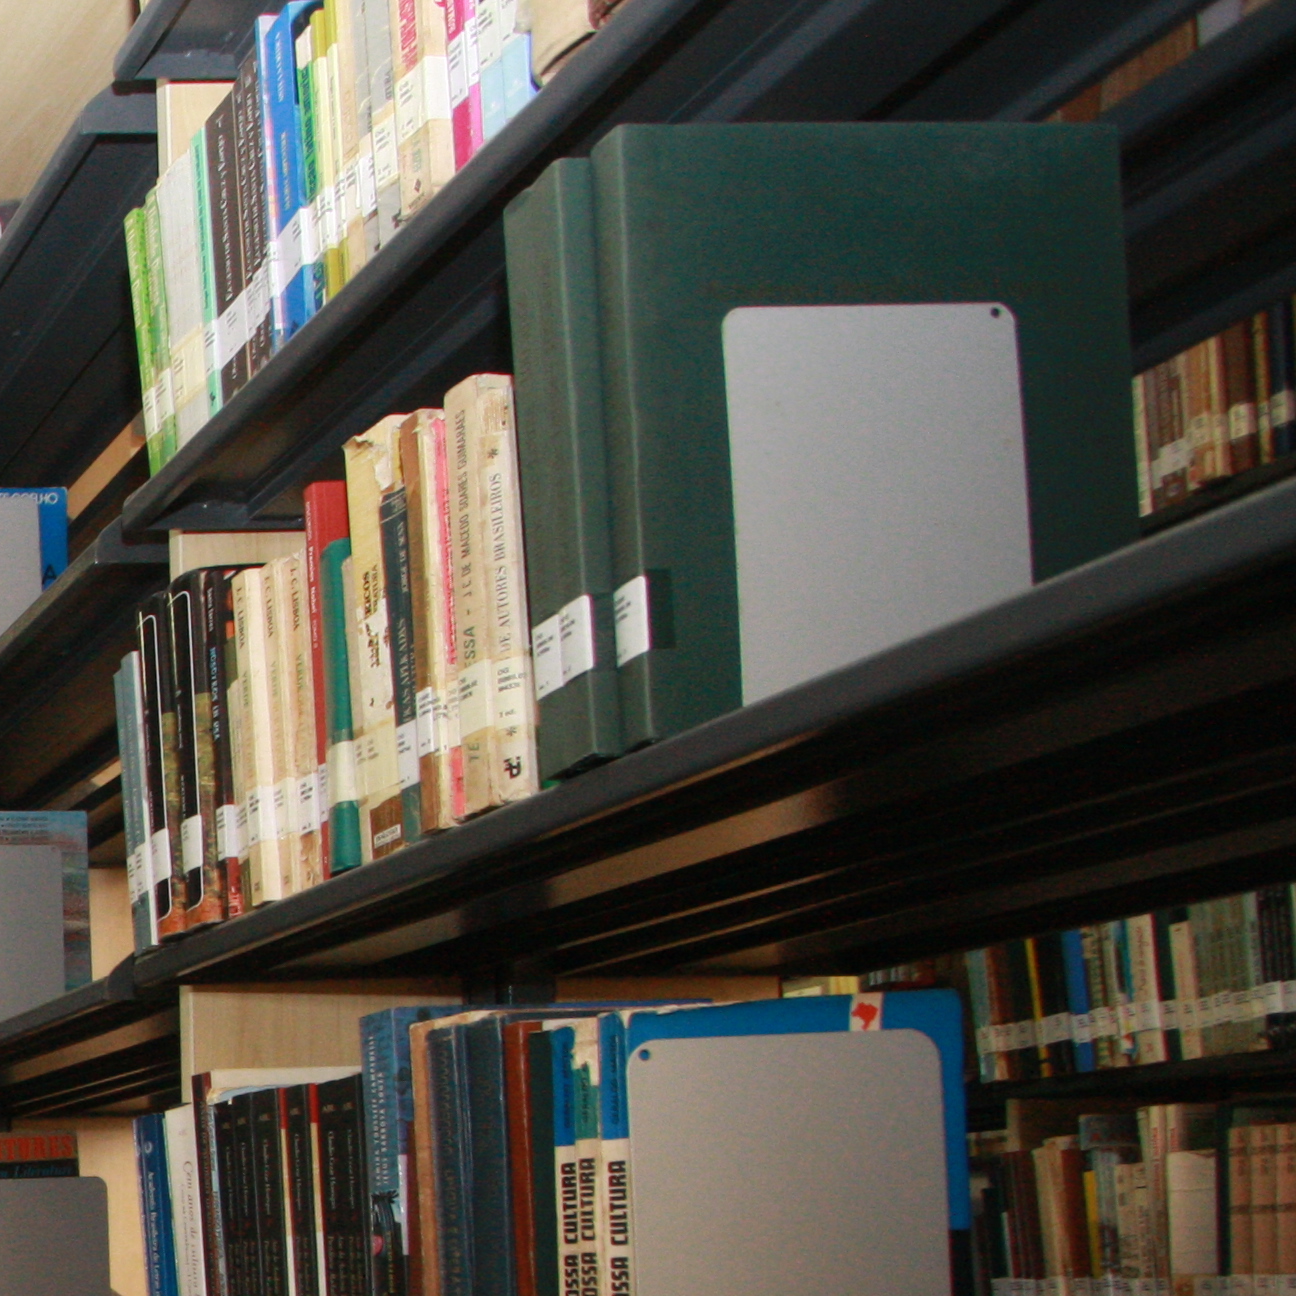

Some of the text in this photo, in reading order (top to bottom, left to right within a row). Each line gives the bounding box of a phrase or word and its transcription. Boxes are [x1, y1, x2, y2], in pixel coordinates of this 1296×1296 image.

[13, 490, 59, 505] COELHO
[456, 470, 469, 510] SOARES
[458, 513, 471, 558] MACEDO
[488, 472, 507, 562] BRASILEIROS
[309, 586, 318, 614] Nobel
[496, 565, 511, 628] AUTORES
[237, 610, 250, 708] LISBOA VERDE
[264, 597, 278, 698] LISBOA VERDE
[291, 591, 303, 691] LISBOA VERDE
[208, 646, 218, 702] NOSOTROS
[379, 1107, 389, 1152] BARBOSA
[14, 1165, 74, 1179] Literature
[147, 1171, 159, 1210] Academia
[182, 1160, 197, 1191] Cem
[381, 1155, 390, 1185] JESUS
[560, 1161, 578, 1244] CULTURA
[577, 1157, 596, 1241] CULTURA
[607, 1159, 628, 1246] CULTURA
[149, 1211, 160, 1252] Brasileira
